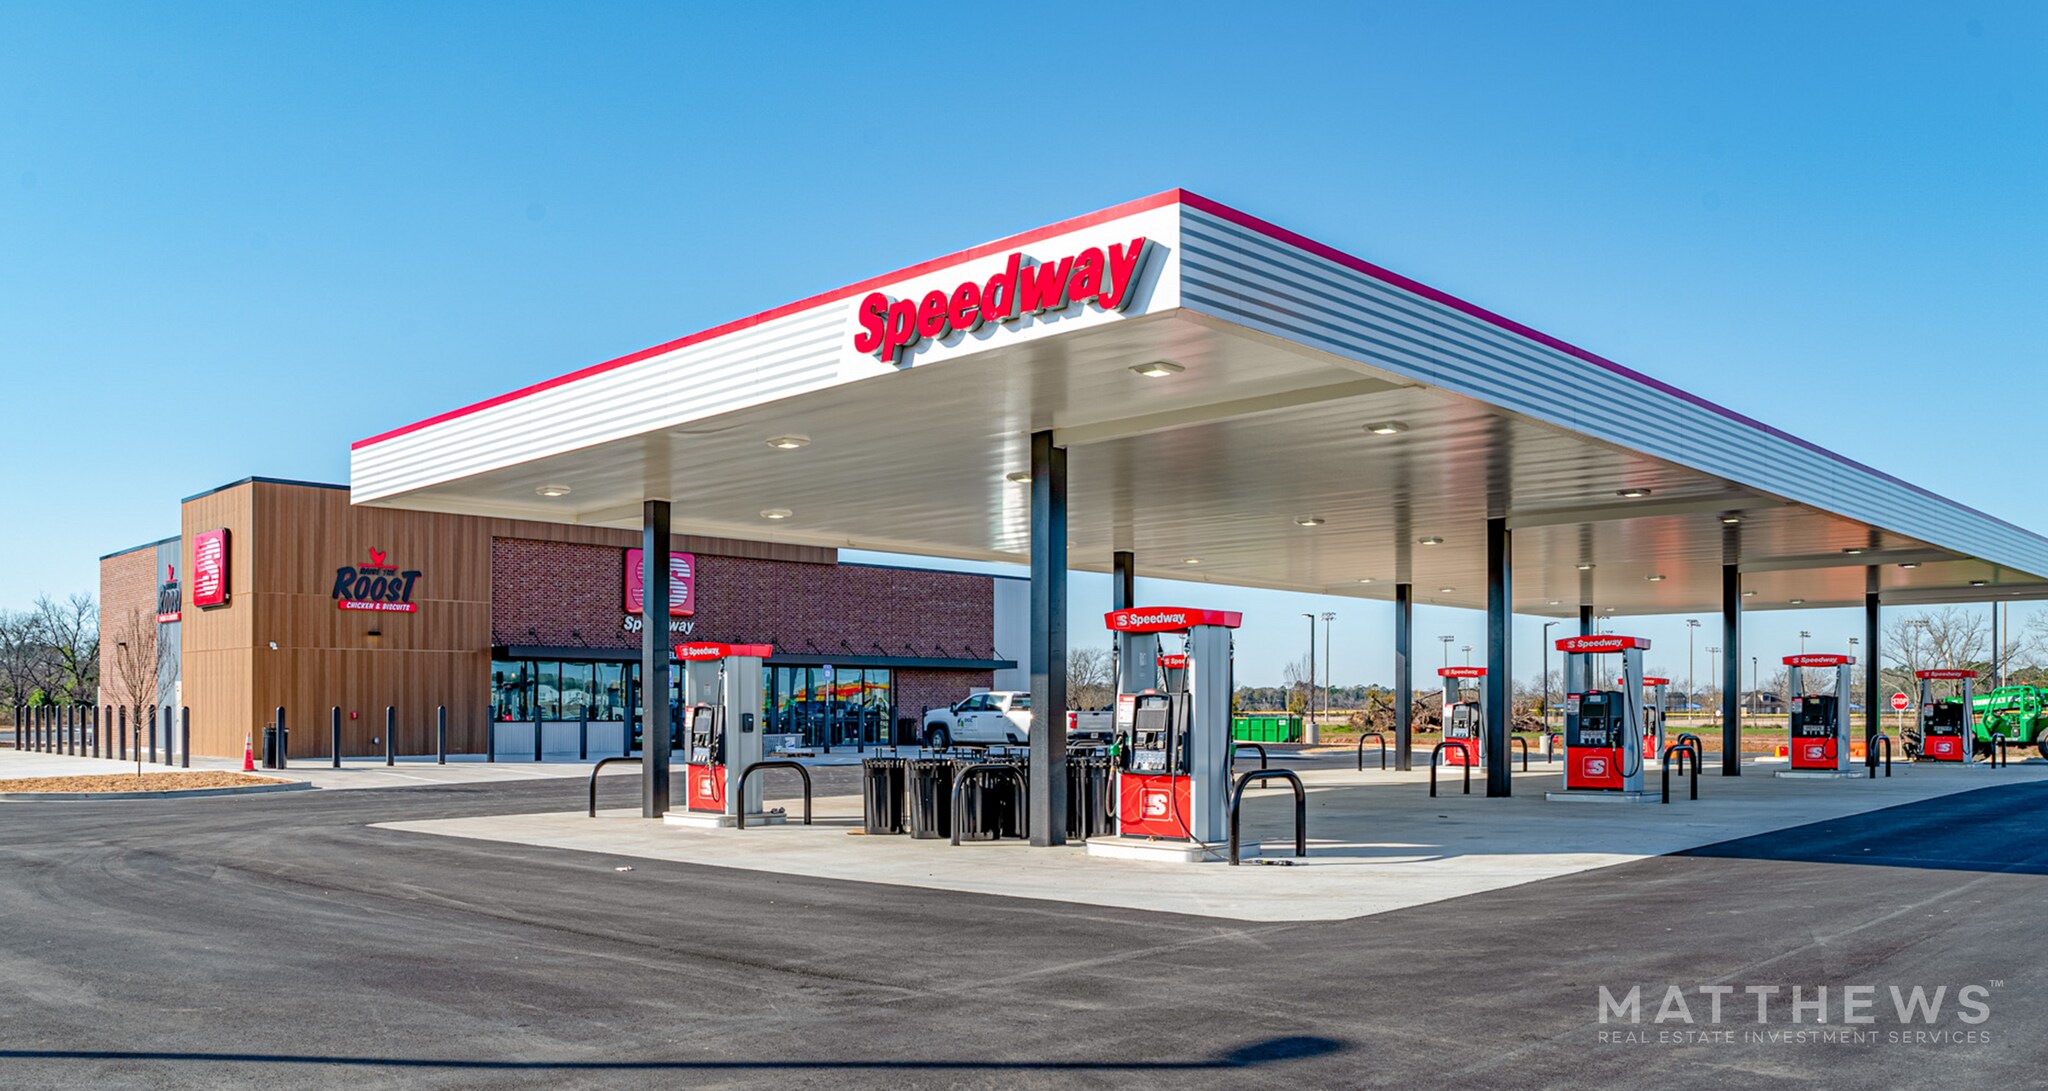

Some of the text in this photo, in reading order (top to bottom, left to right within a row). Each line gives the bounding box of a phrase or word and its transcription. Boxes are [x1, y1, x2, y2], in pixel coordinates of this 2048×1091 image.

[854, 236, 1148, 364] Speedway
[332, 566, 422, 603] ROOST
[346, 602, 374, 610] CHICKEN
[382, 603, 410, 611] BISCUITS
[623, 616, 695, 635] Spway
[1892, 697, 1909, 706] STOP
